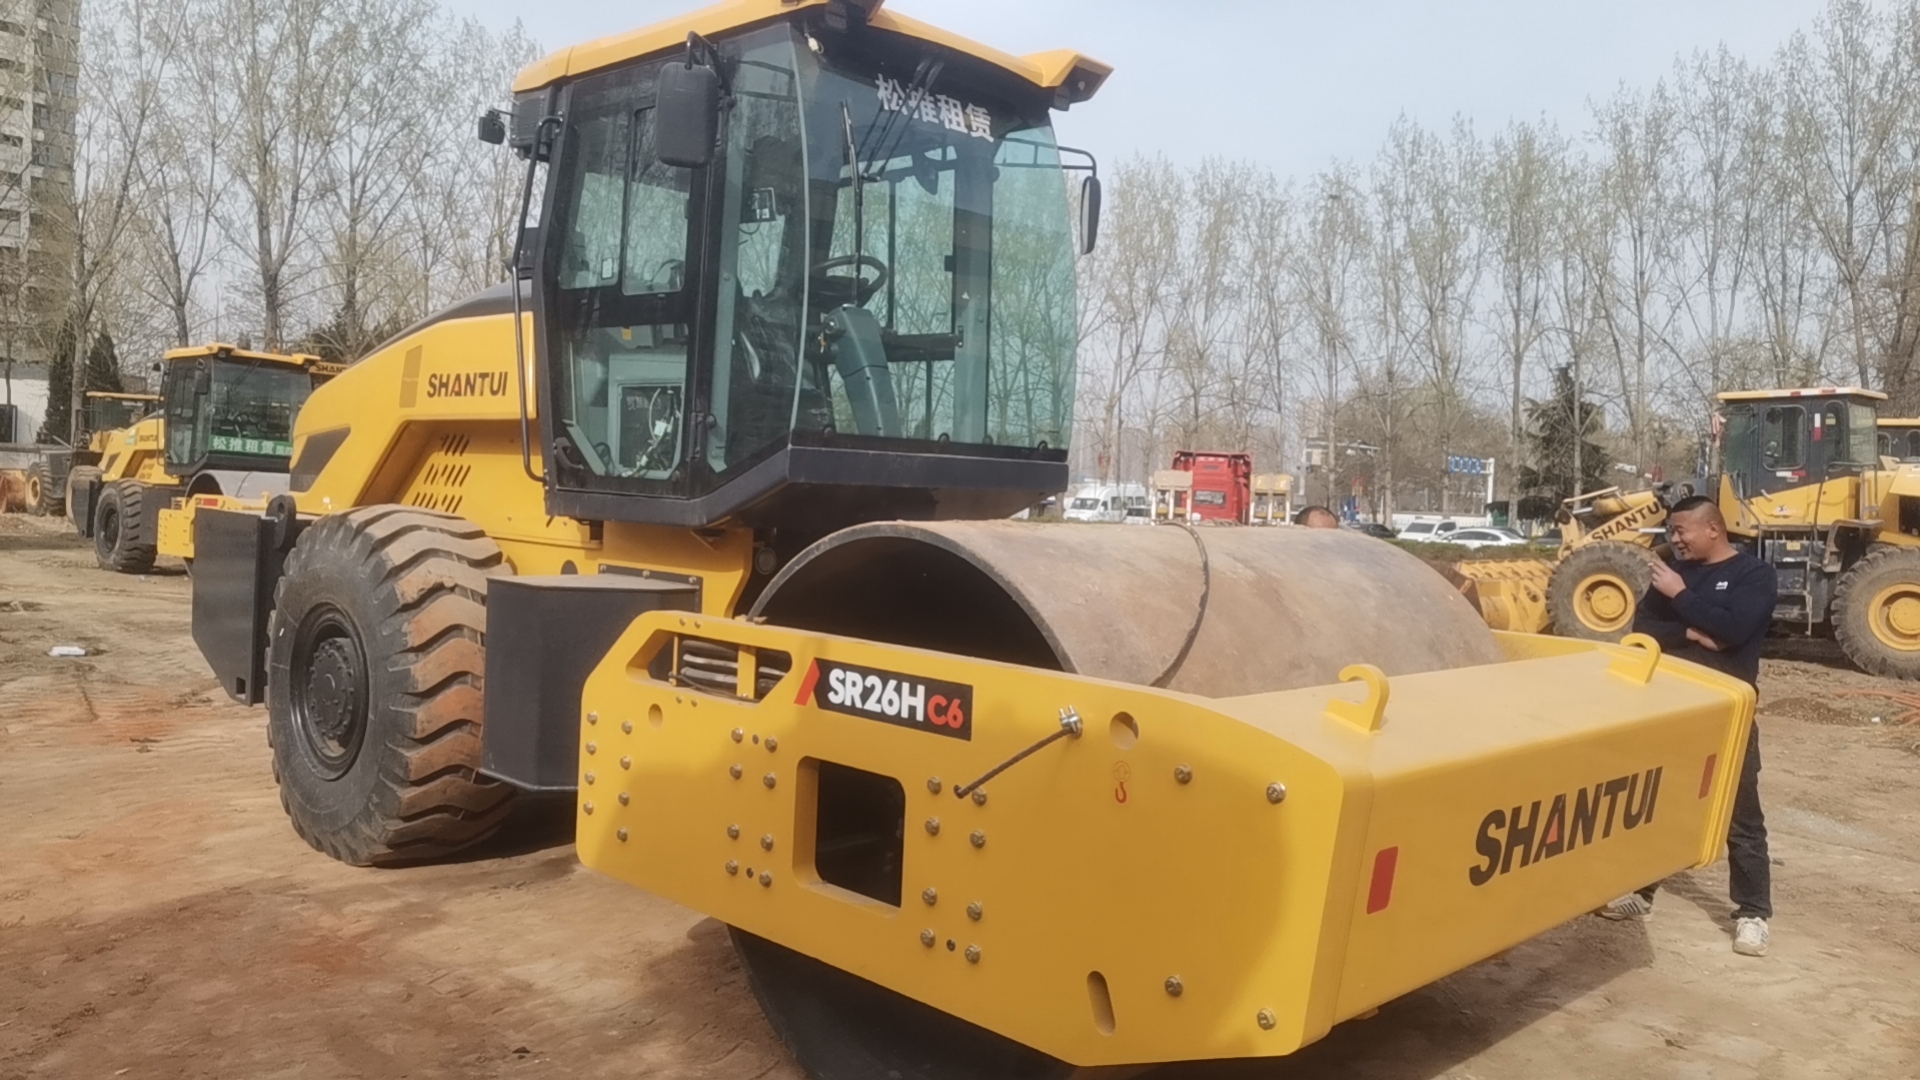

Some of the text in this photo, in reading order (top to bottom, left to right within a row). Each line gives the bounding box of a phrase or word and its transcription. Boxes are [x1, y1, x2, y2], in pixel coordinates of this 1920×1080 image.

[875, 73, 994, 142] 松推租赁
[427, 371, 508, 398] SHANTUI
[827, 668, 964, 729] SR26H C6
[1469, 766, 1663, 887] SHANTUI
